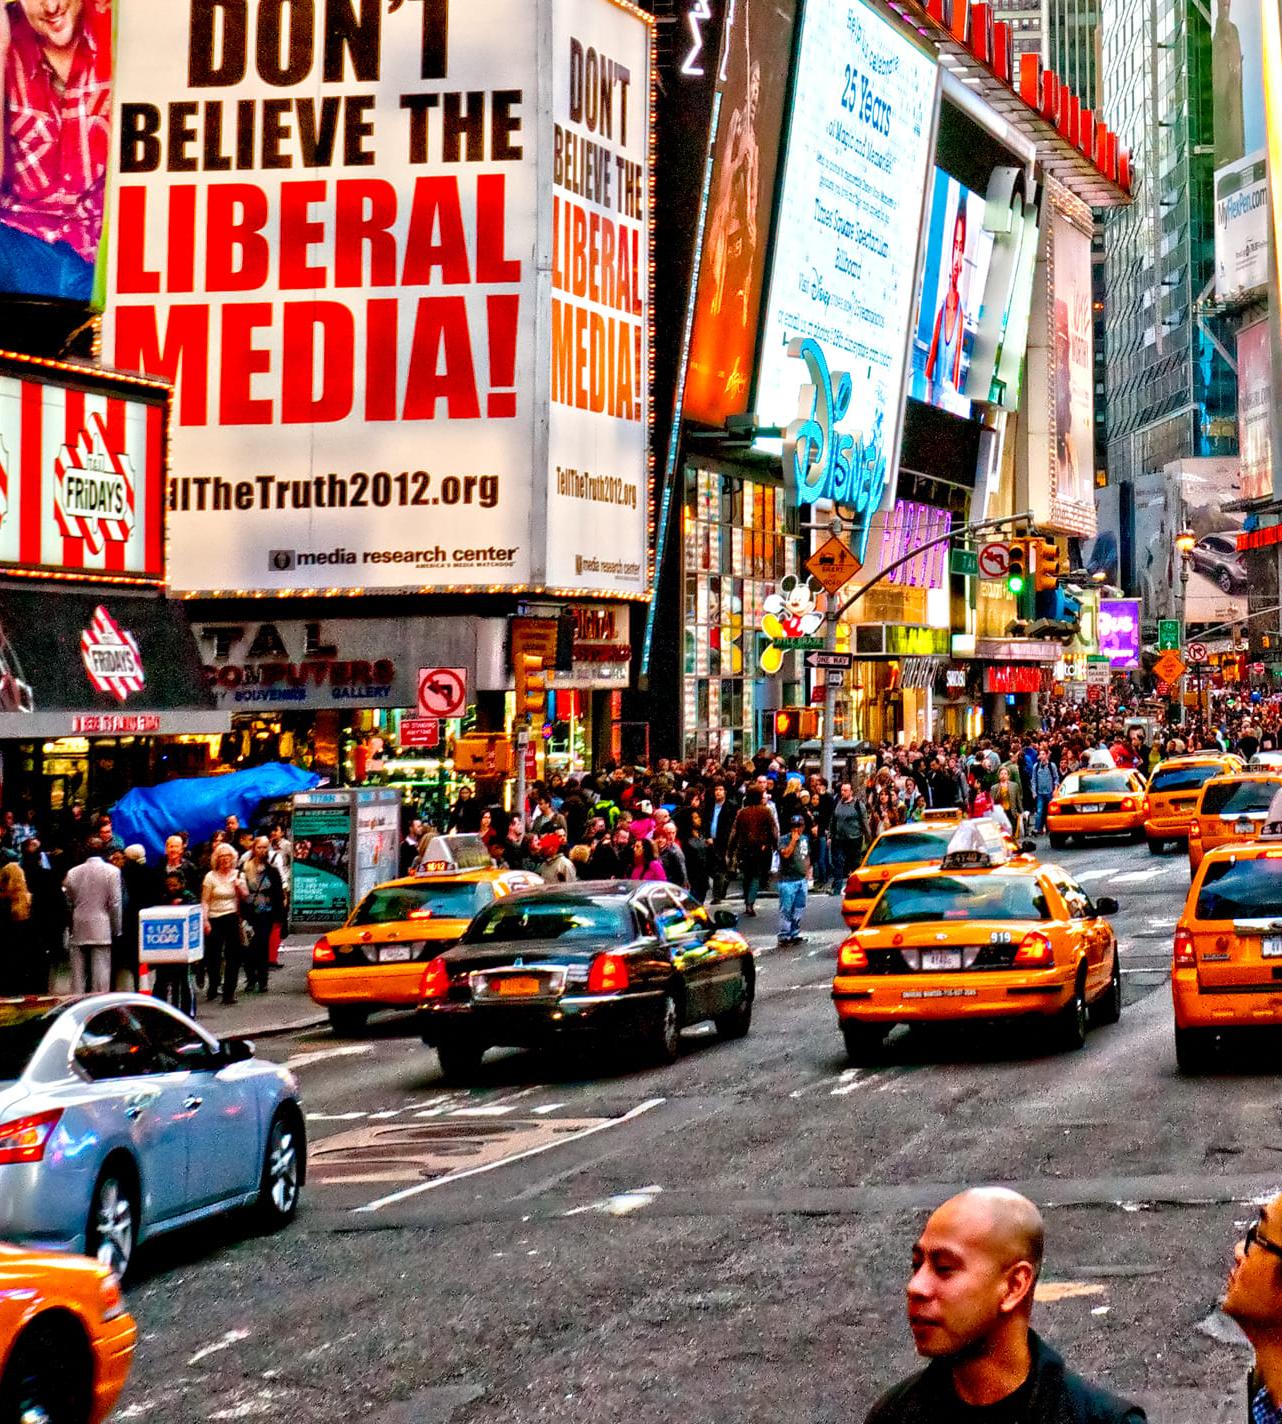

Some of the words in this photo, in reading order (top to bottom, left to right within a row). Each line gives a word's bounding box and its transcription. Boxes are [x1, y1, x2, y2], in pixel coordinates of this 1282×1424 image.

[118, 93, 377, 175] BELIEVE
[400, 89, 524, 164] THE
[840, 63, 859, 114] 25
[858, 74, 893, 138] Years
[553, 121, 612, 209] BELIEVE
[615, 154, 643, 222] THE
[114, 172, 523, 296] LIBERAL
[551, 193, 644, 317] LIBERAL
[112, 292, 521, 429] MEDIA!
[550, 295, 642, 423] MEDIA!
[555, 465, 637, 510] TellTheTruth2012.org
[296, 548, 357, 566] media
[362, 545, 447, 564] research
[451, 545, 517, 562] center
[331, 685, 391, 700] GALLERY
[816, 655, 830, 665] ONE
[833, 654, 848, 665] WAY
[145, 932, 181, 945] TODAY
[990, 931, 1012, 944] 919
